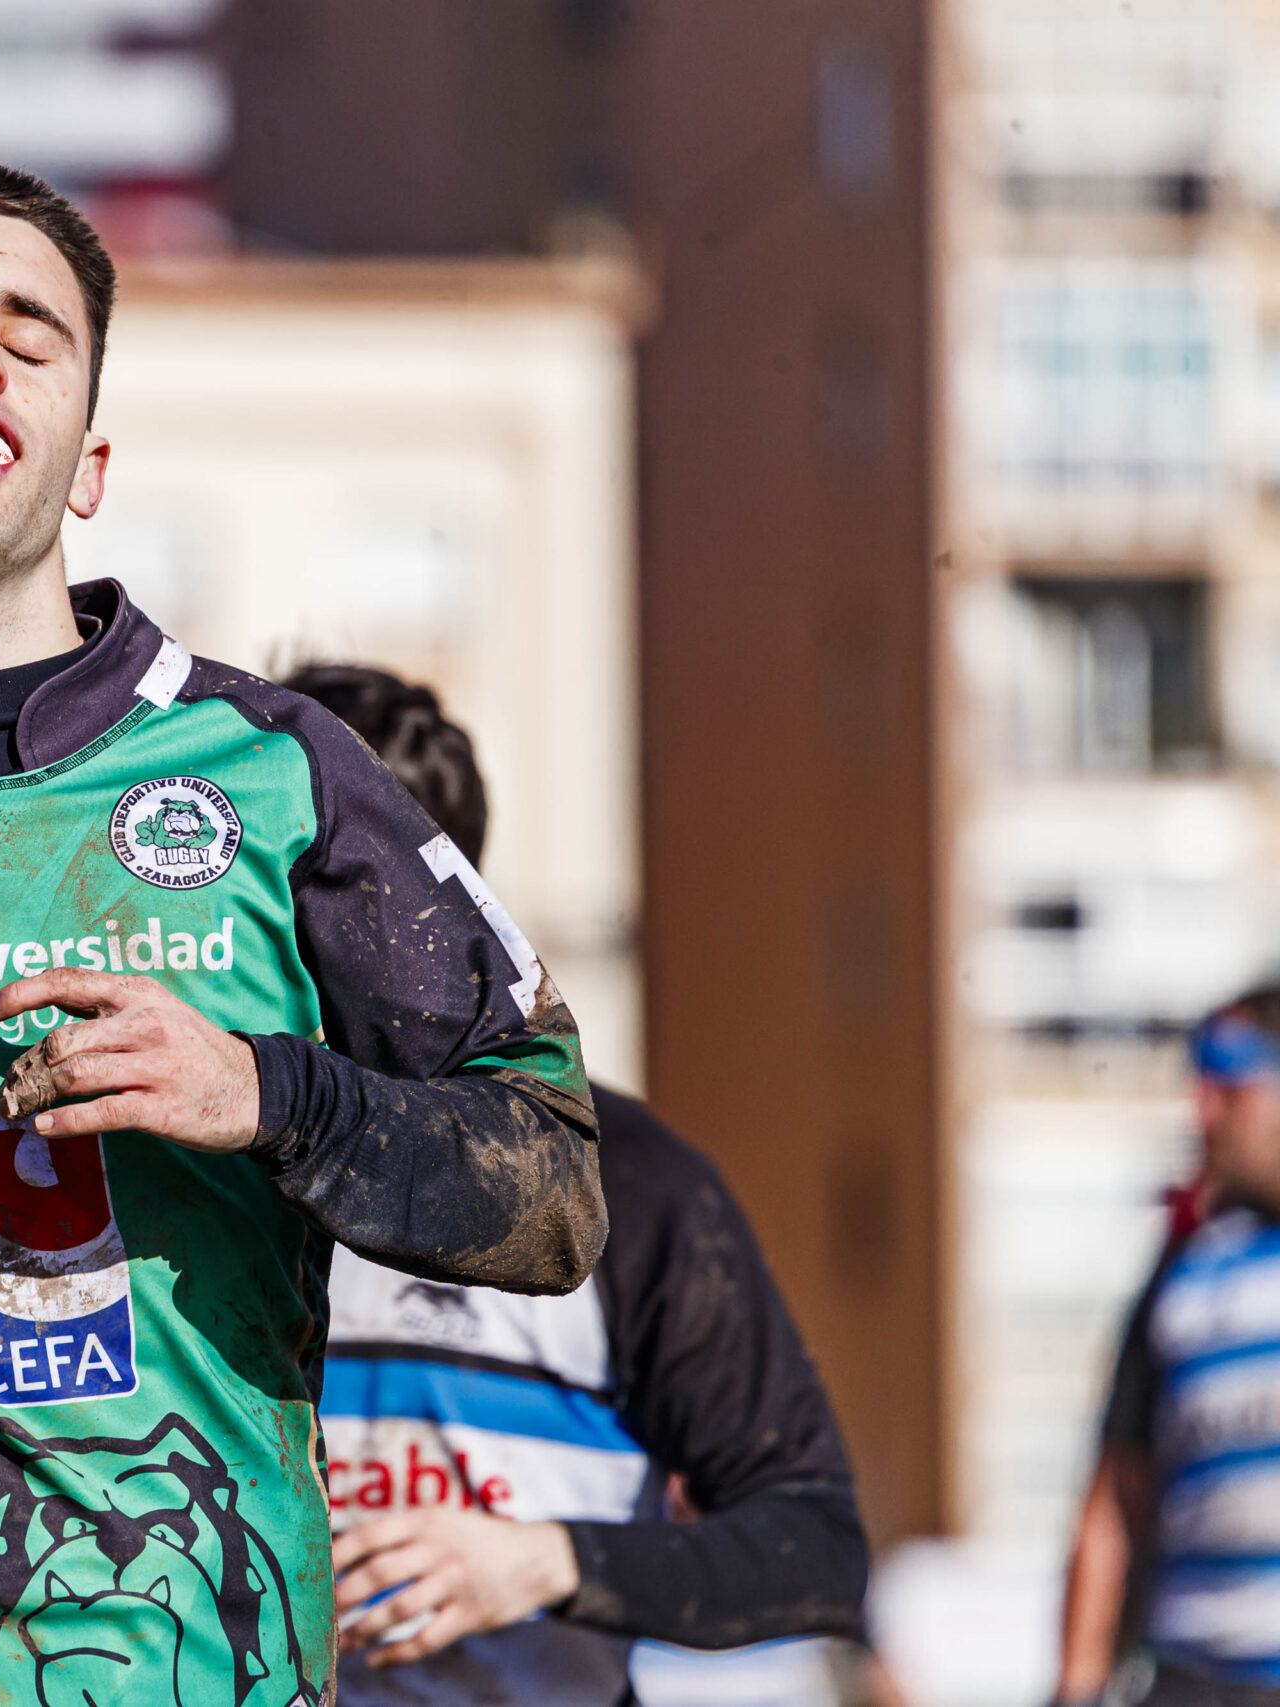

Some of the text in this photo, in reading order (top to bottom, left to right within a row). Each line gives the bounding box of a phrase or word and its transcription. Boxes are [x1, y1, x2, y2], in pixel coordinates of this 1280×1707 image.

[113, 778, 238, 863] CLUB DEPORTIVO UNIVERSITARIO
[141, 866, 218, 886] ZARAGOZA
[154, 848, 210, 866] RUGBY
[327, 1444, 512, 1510] cable
